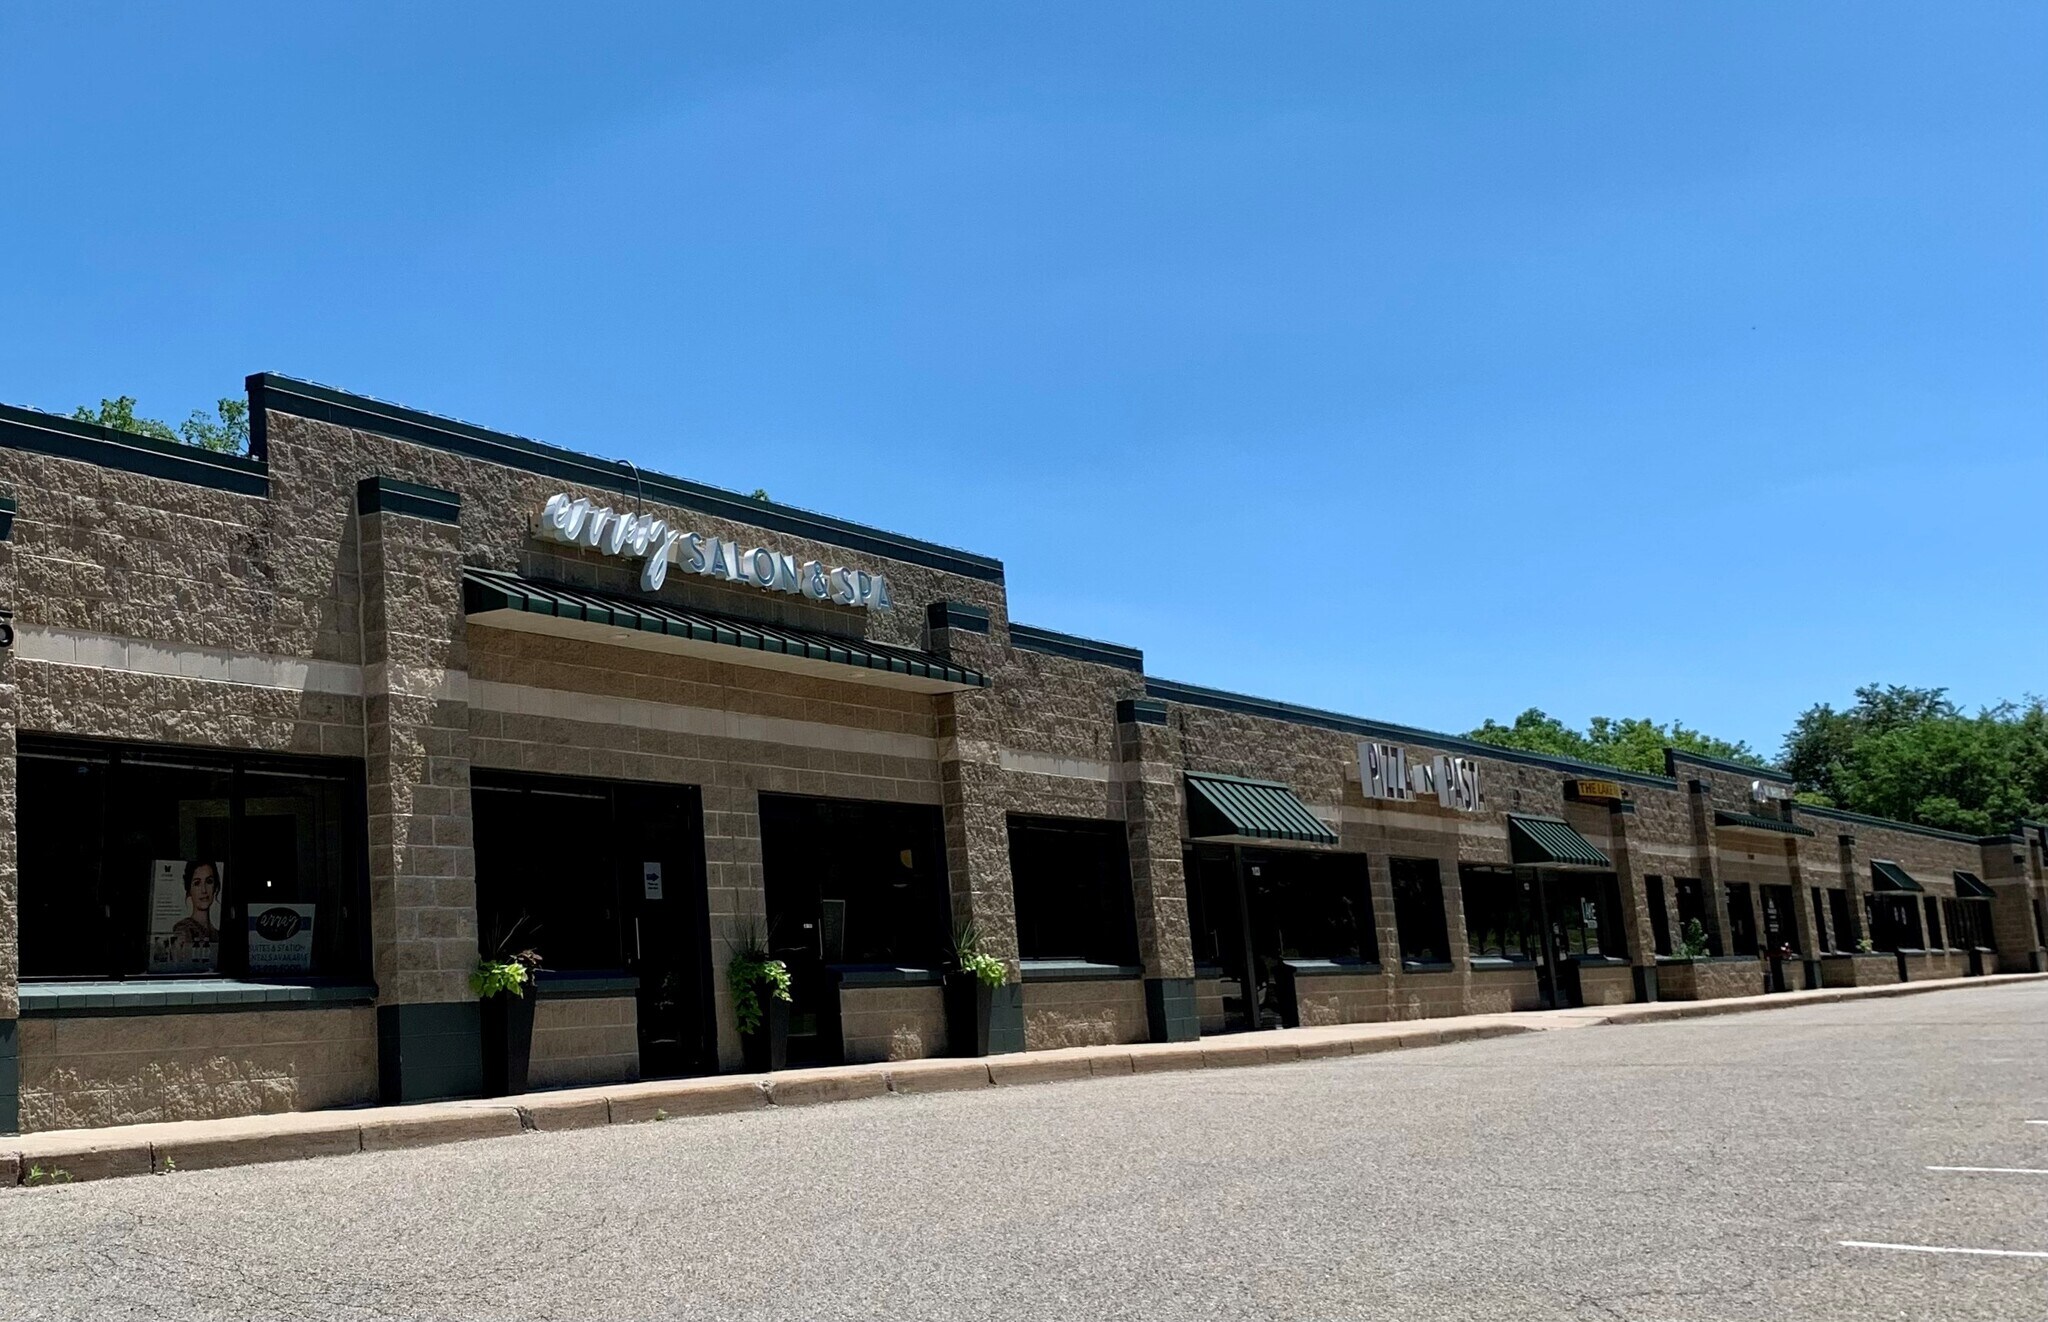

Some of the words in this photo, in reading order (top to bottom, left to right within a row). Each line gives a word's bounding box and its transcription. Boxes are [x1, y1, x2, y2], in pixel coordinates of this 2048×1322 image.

[678, 531, 800, 595] SALON
[801, 559, 830, 600] &
[829, 566, 893, 614] SPA
[1412, 763, 1438, 795] N
[1579, 782, 1597, 795] THE
[260, 913, 299, 938] array
